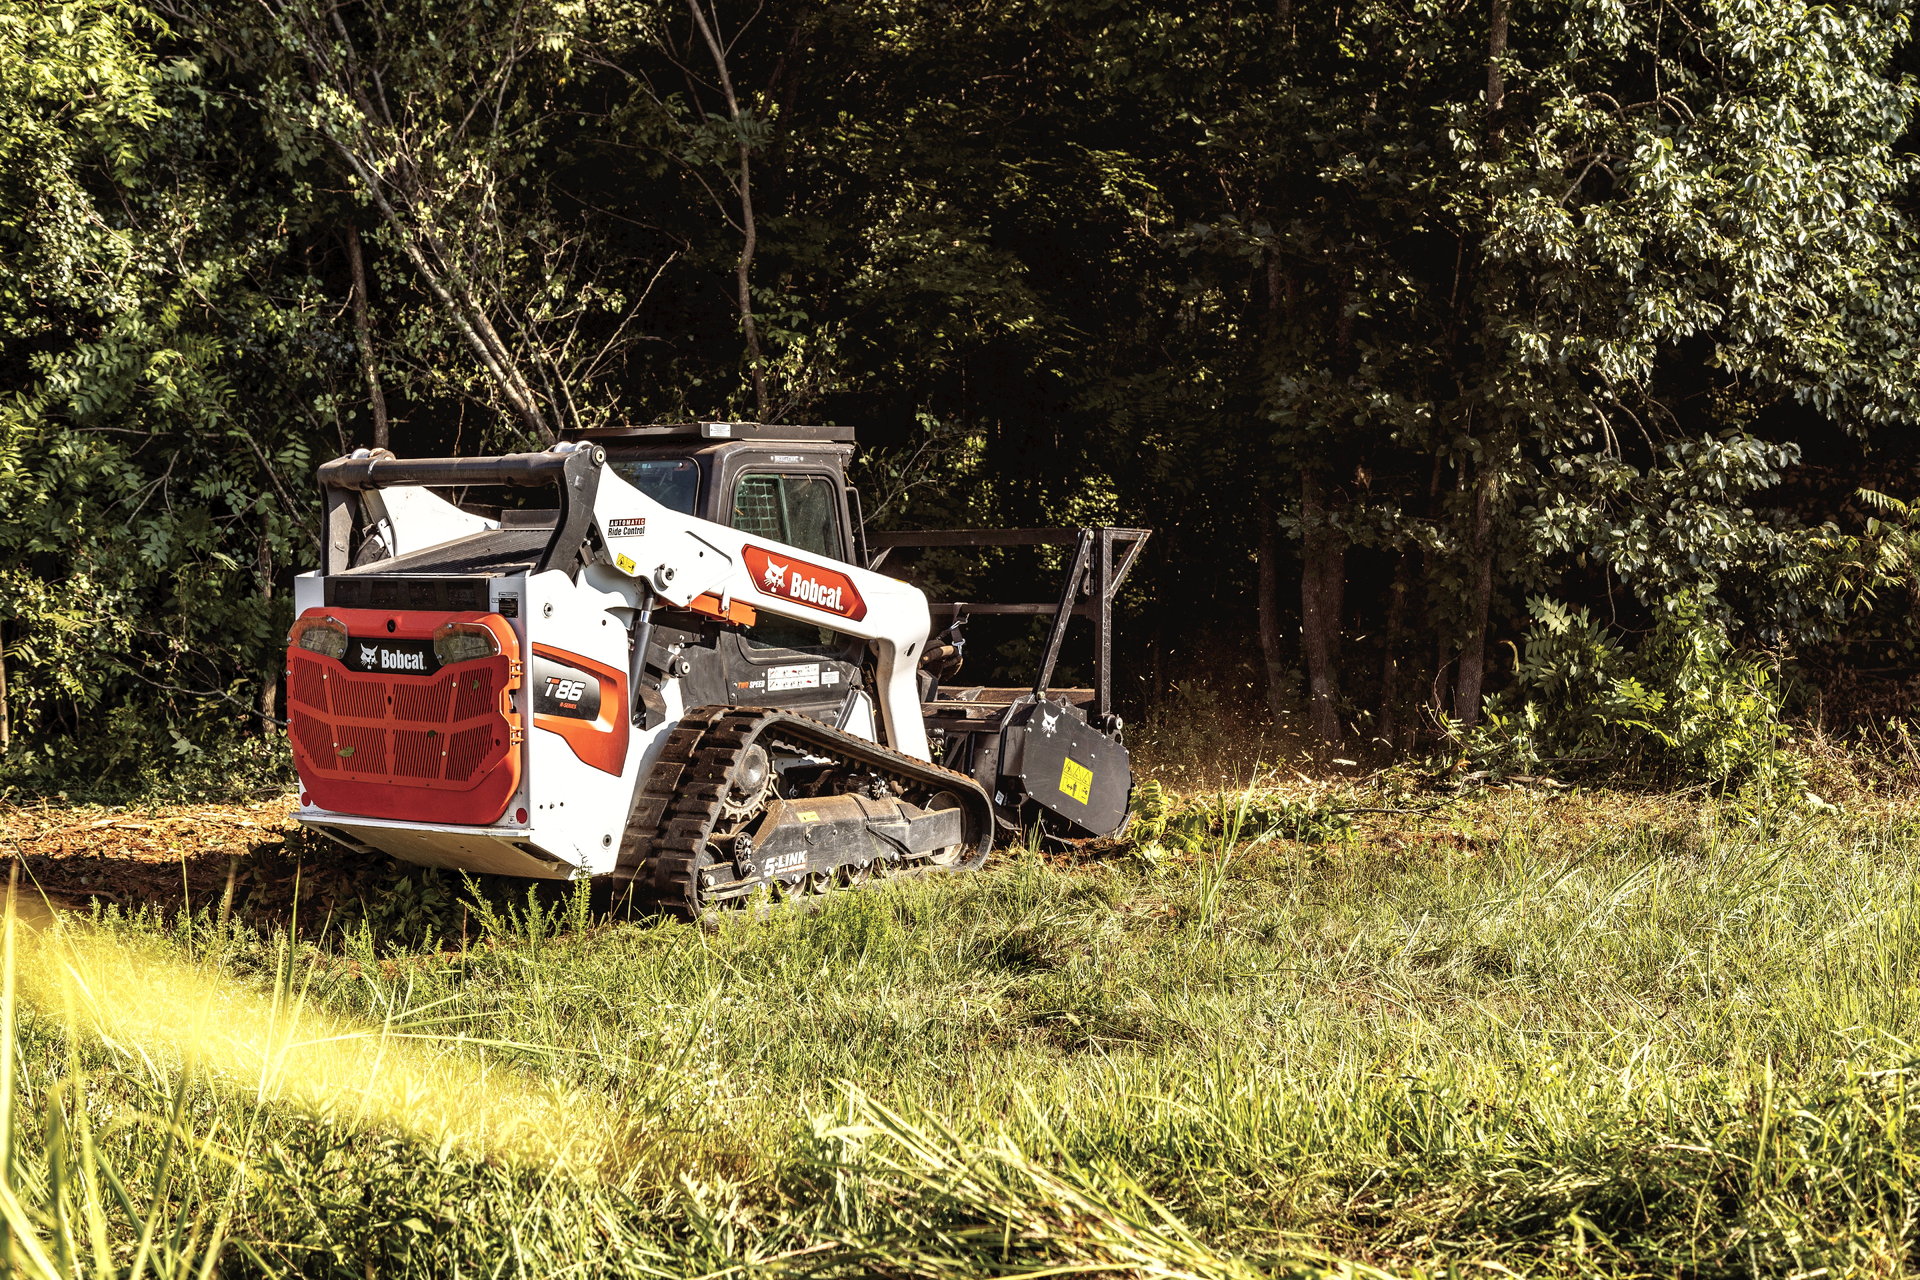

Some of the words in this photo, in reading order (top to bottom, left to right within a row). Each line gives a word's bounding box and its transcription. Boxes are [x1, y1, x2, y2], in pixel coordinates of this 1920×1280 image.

[608, 527, 622, 536] Ride
[623, 526, 645, 535] Control
[790, 572, 842, 611] Bobcat
[381, 649, 424, 670] Bobcat
[545, 676, 586, 701] T86
[738, 681, 749, 689] TWO
[749, 680, 765, 689] SPEED
